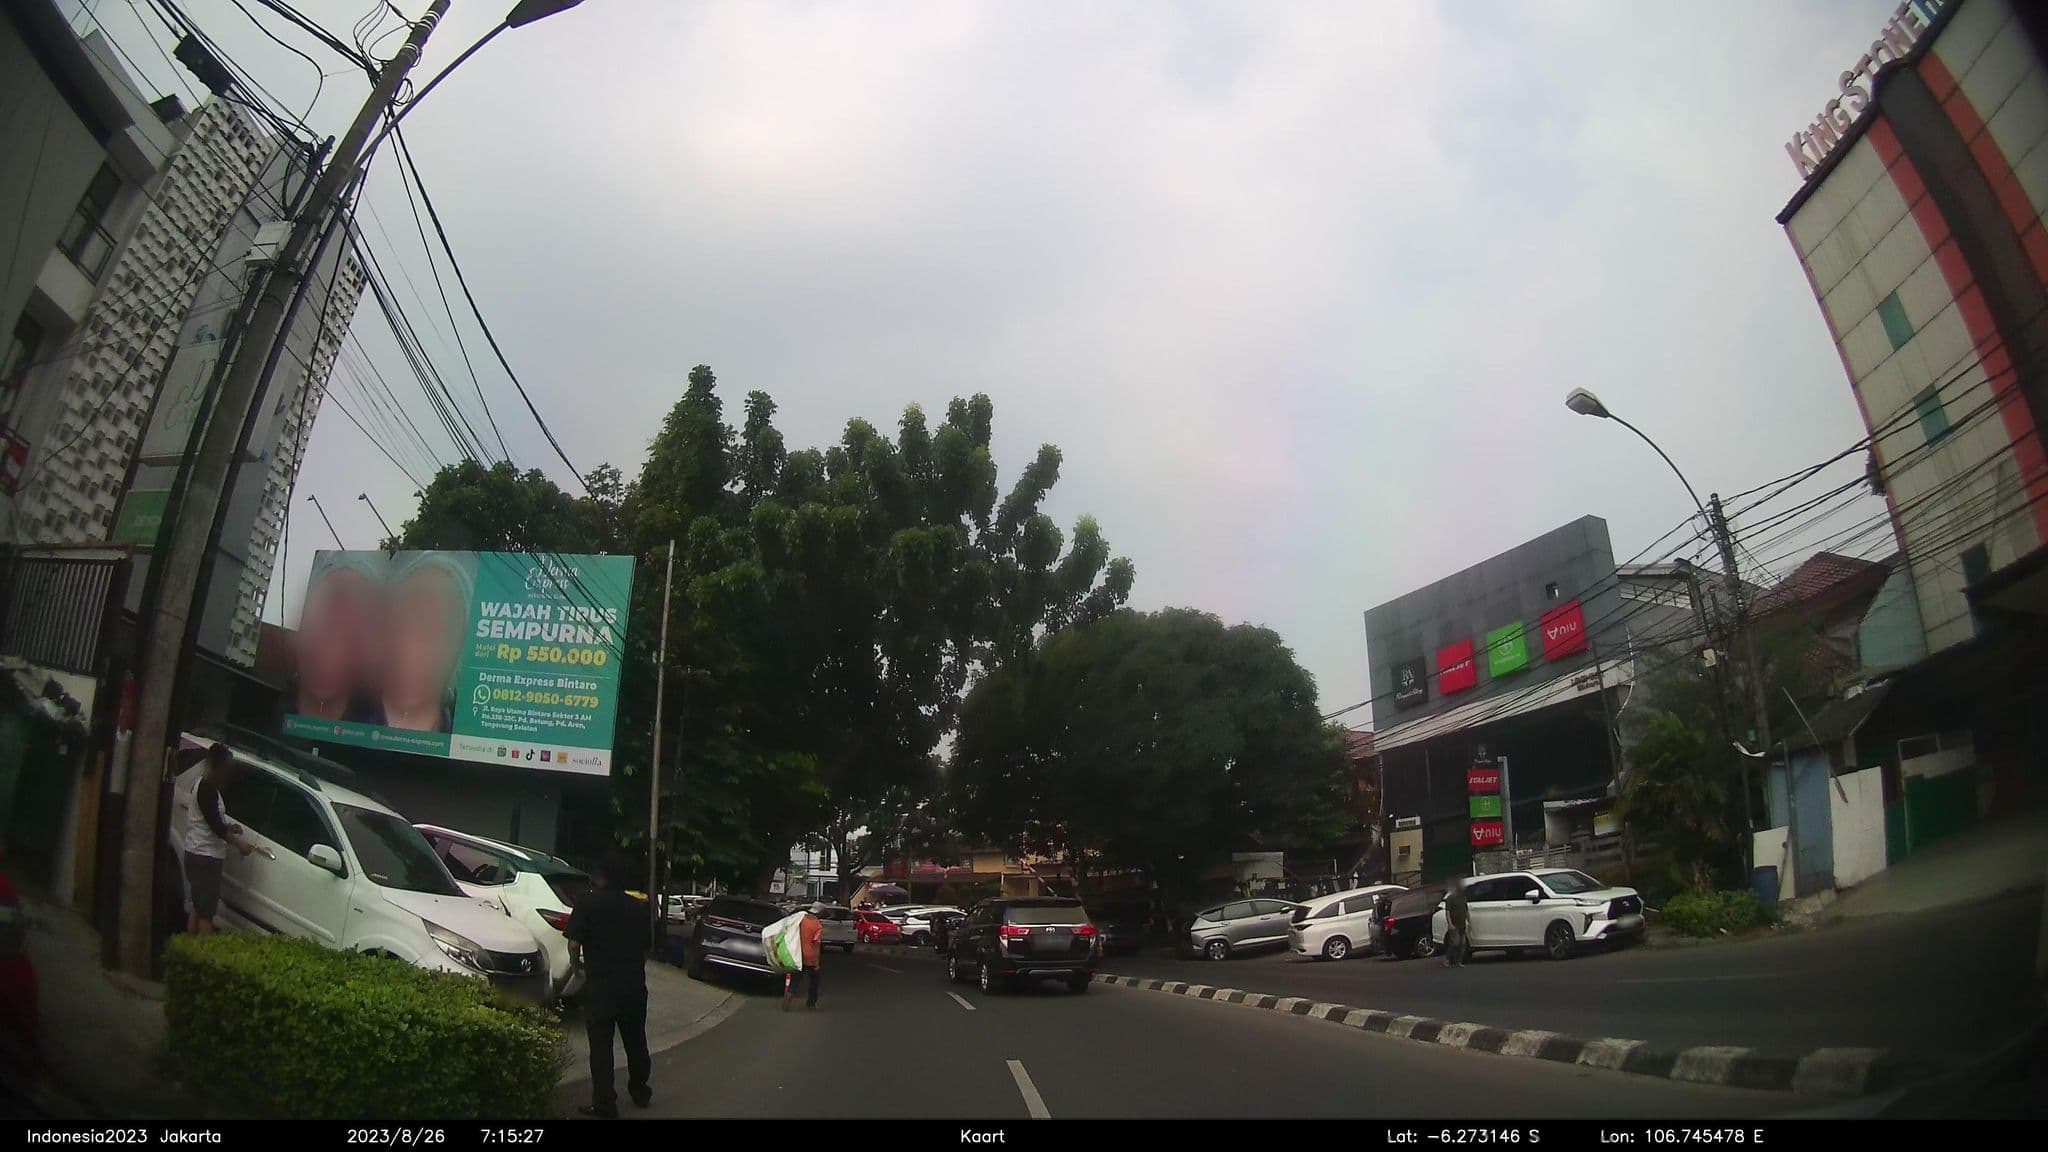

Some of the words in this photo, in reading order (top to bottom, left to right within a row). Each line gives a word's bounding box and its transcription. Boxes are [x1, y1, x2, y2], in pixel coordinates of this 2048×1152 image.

[480, 601, 552, 620] WAJAH
[557, 605, 617, 624] TIRUS
[476, 619, 613, 645] SEMPURNA
[496, 643, 522, 663] Rp
[527, 646, 607, 666] 550.000
[479, 672, 512, 684] Derma
[514, 675, 555, 688] Express
[557, 678, 598, 691] Bintaro
[492, 688, 600, 708] 0812-9050-6779
